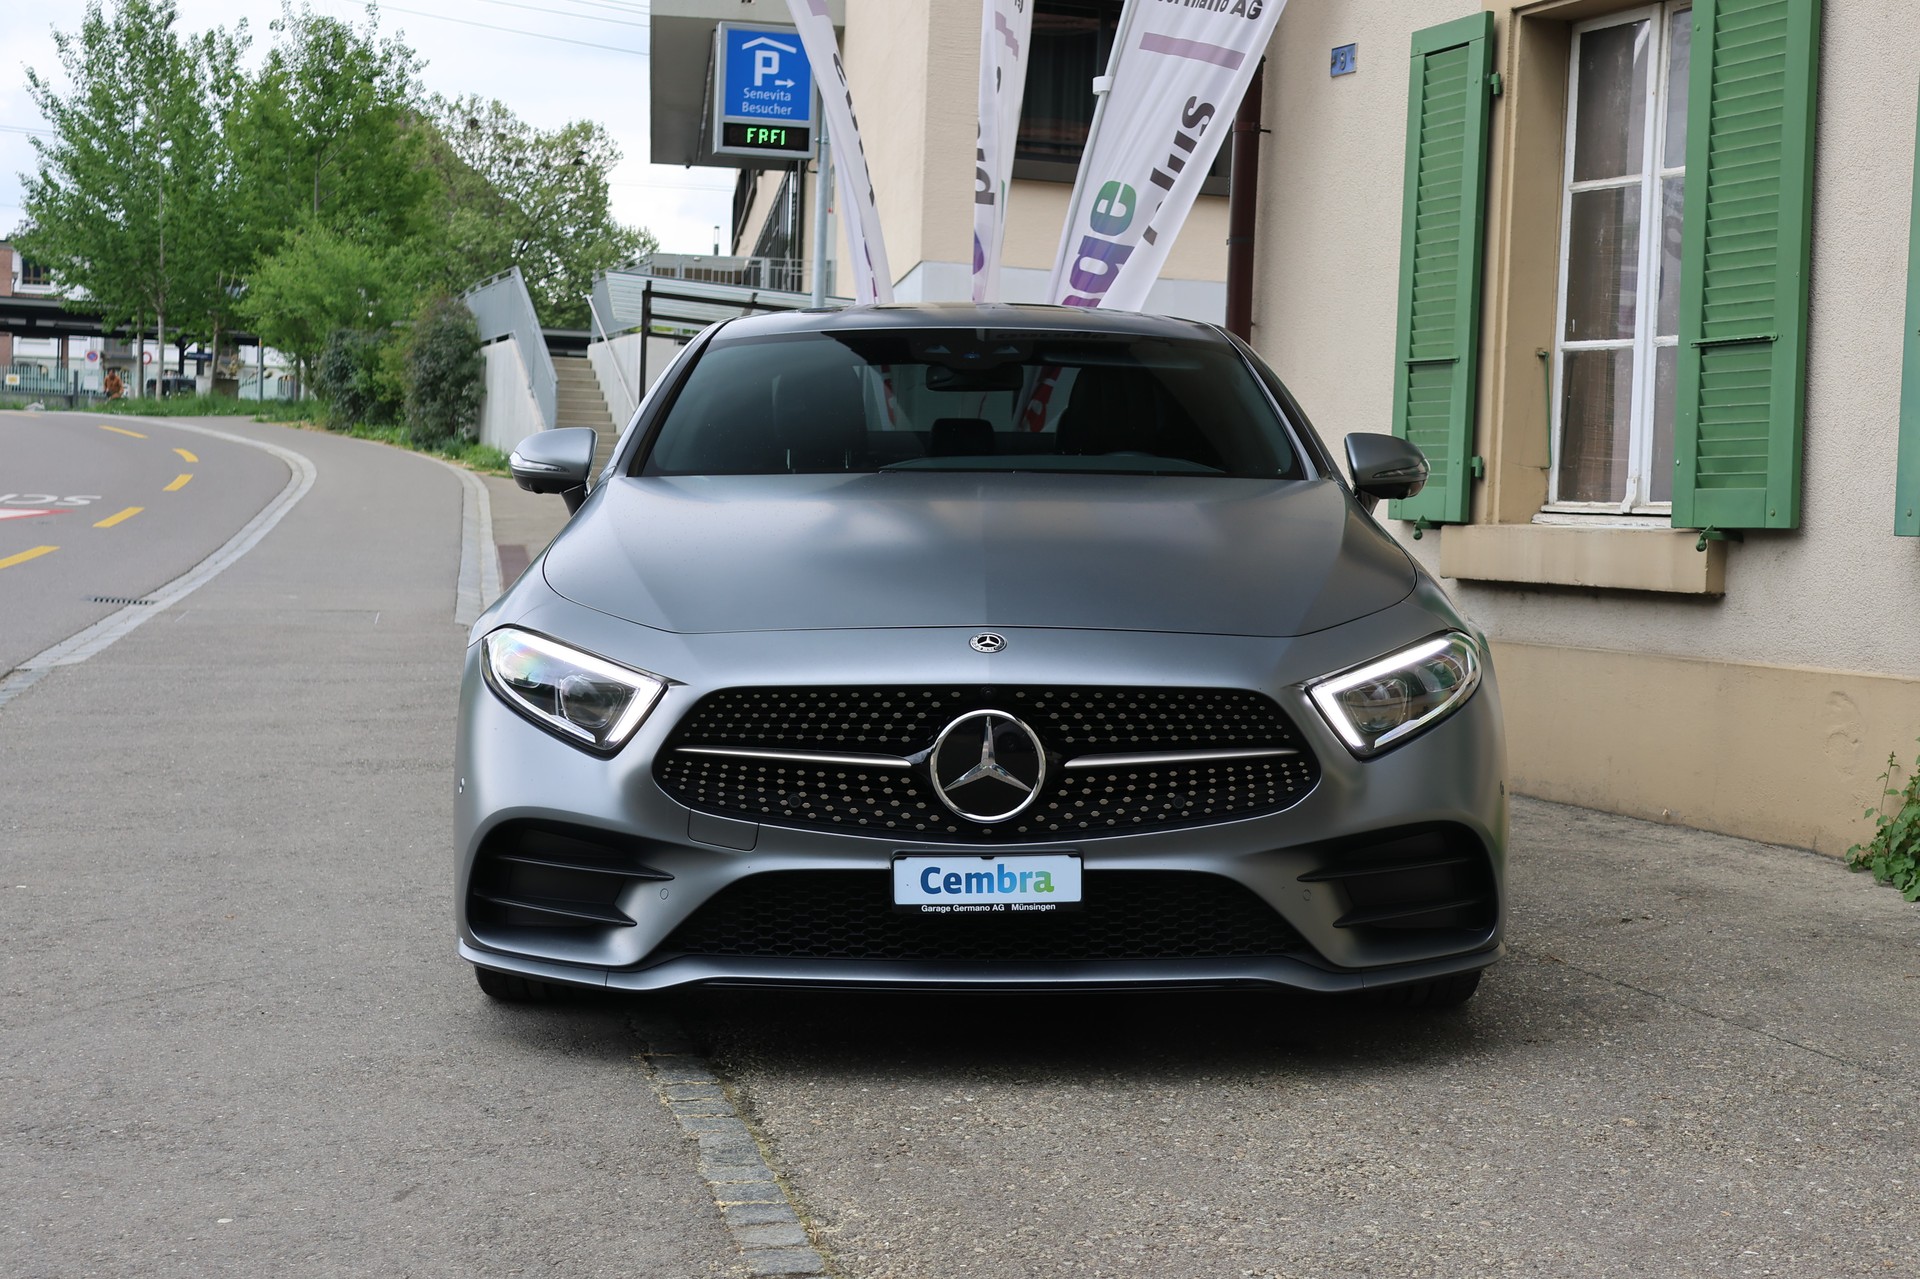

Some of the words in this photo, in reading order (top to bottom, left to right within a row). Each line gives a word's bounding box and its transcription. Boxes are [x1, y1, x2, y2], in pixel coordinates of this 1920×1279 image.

[1230, 0, 1263, 20] AG
[754, 50, 780, 87] P
[743, 87, 792, 101] Senevita
[742, 101, 793, 115] Besucher
[920, 863, 1055, 895] Cembra
[921, 904, 951, 913] Garage
[953, 904, 991, 912] Germano
[992, 904, 1005, 912] AG
[1011, 903, 1056, 913] Münsingen
